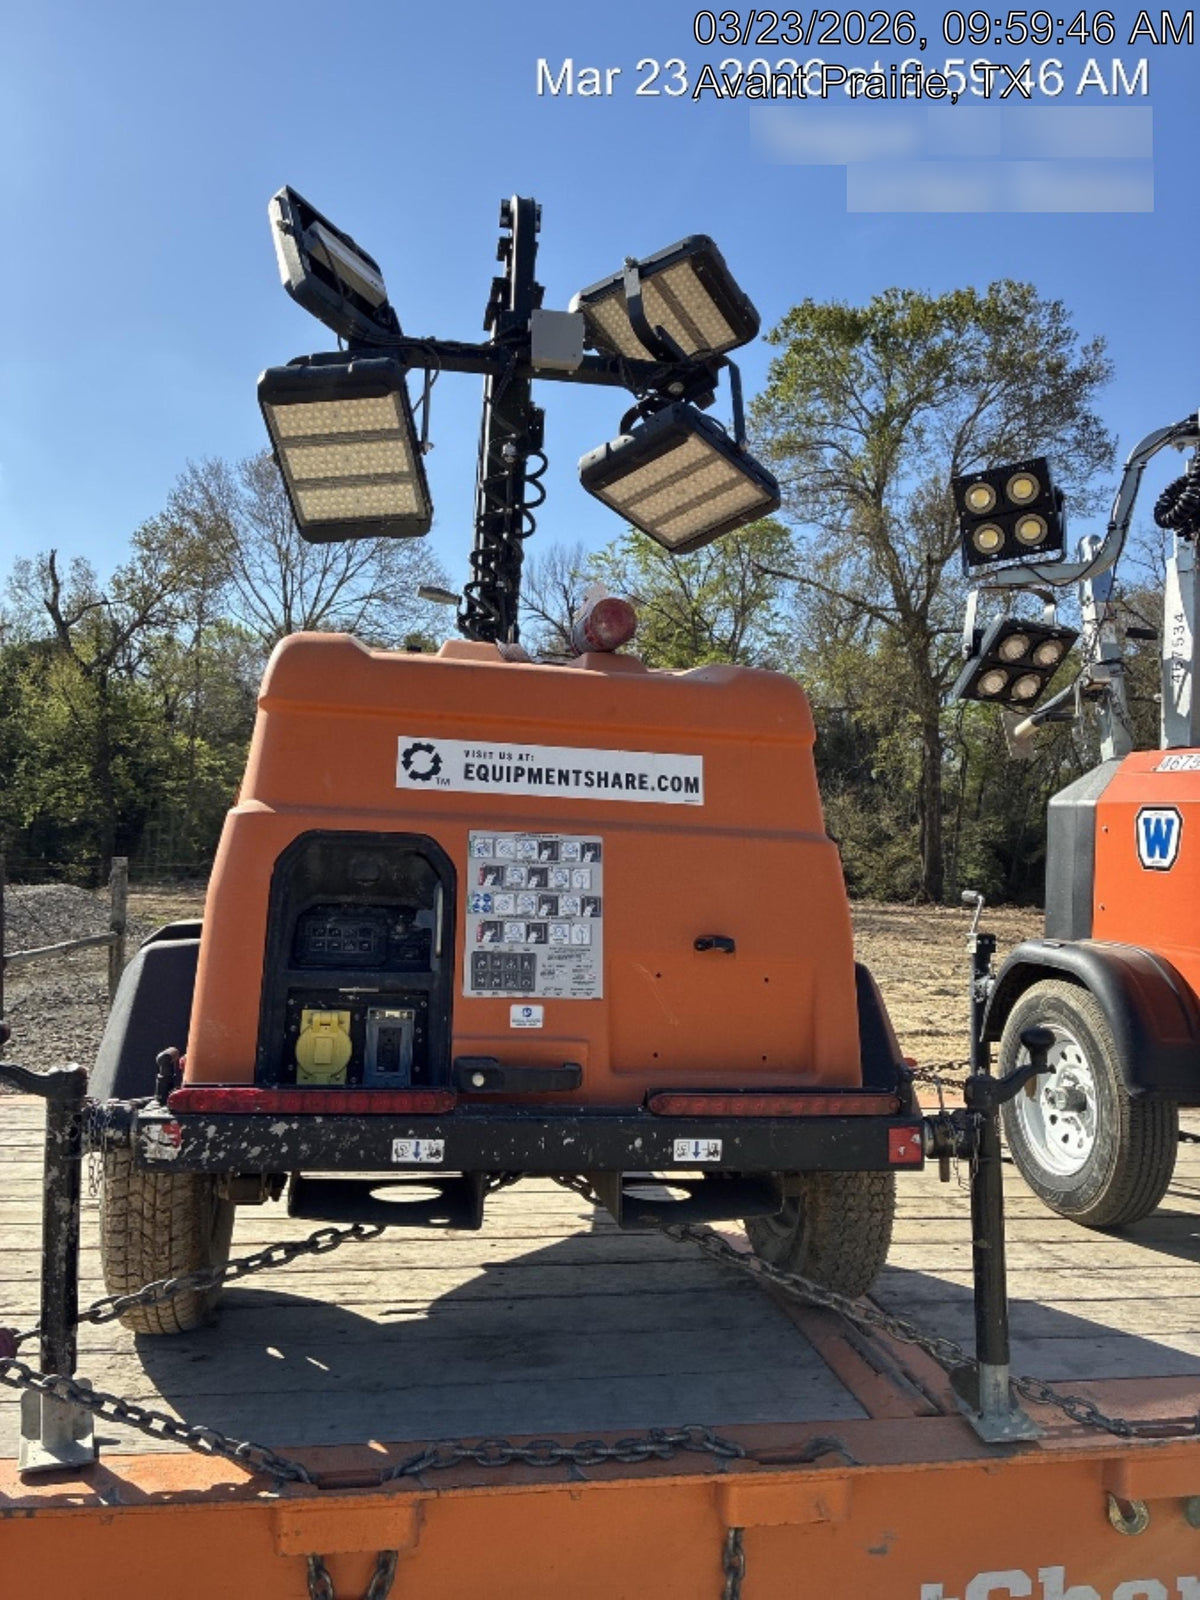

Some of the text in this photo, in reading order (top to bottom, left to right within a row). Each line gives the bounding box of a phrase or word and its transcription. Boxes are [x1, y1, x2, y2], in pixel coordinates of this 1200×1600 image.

[463, 749, 535, 763] VISIT US AT:
[463, 762, 700, 794] EQUIPMENTSHARE.COM
[1142, 817, 1175, 860] W
